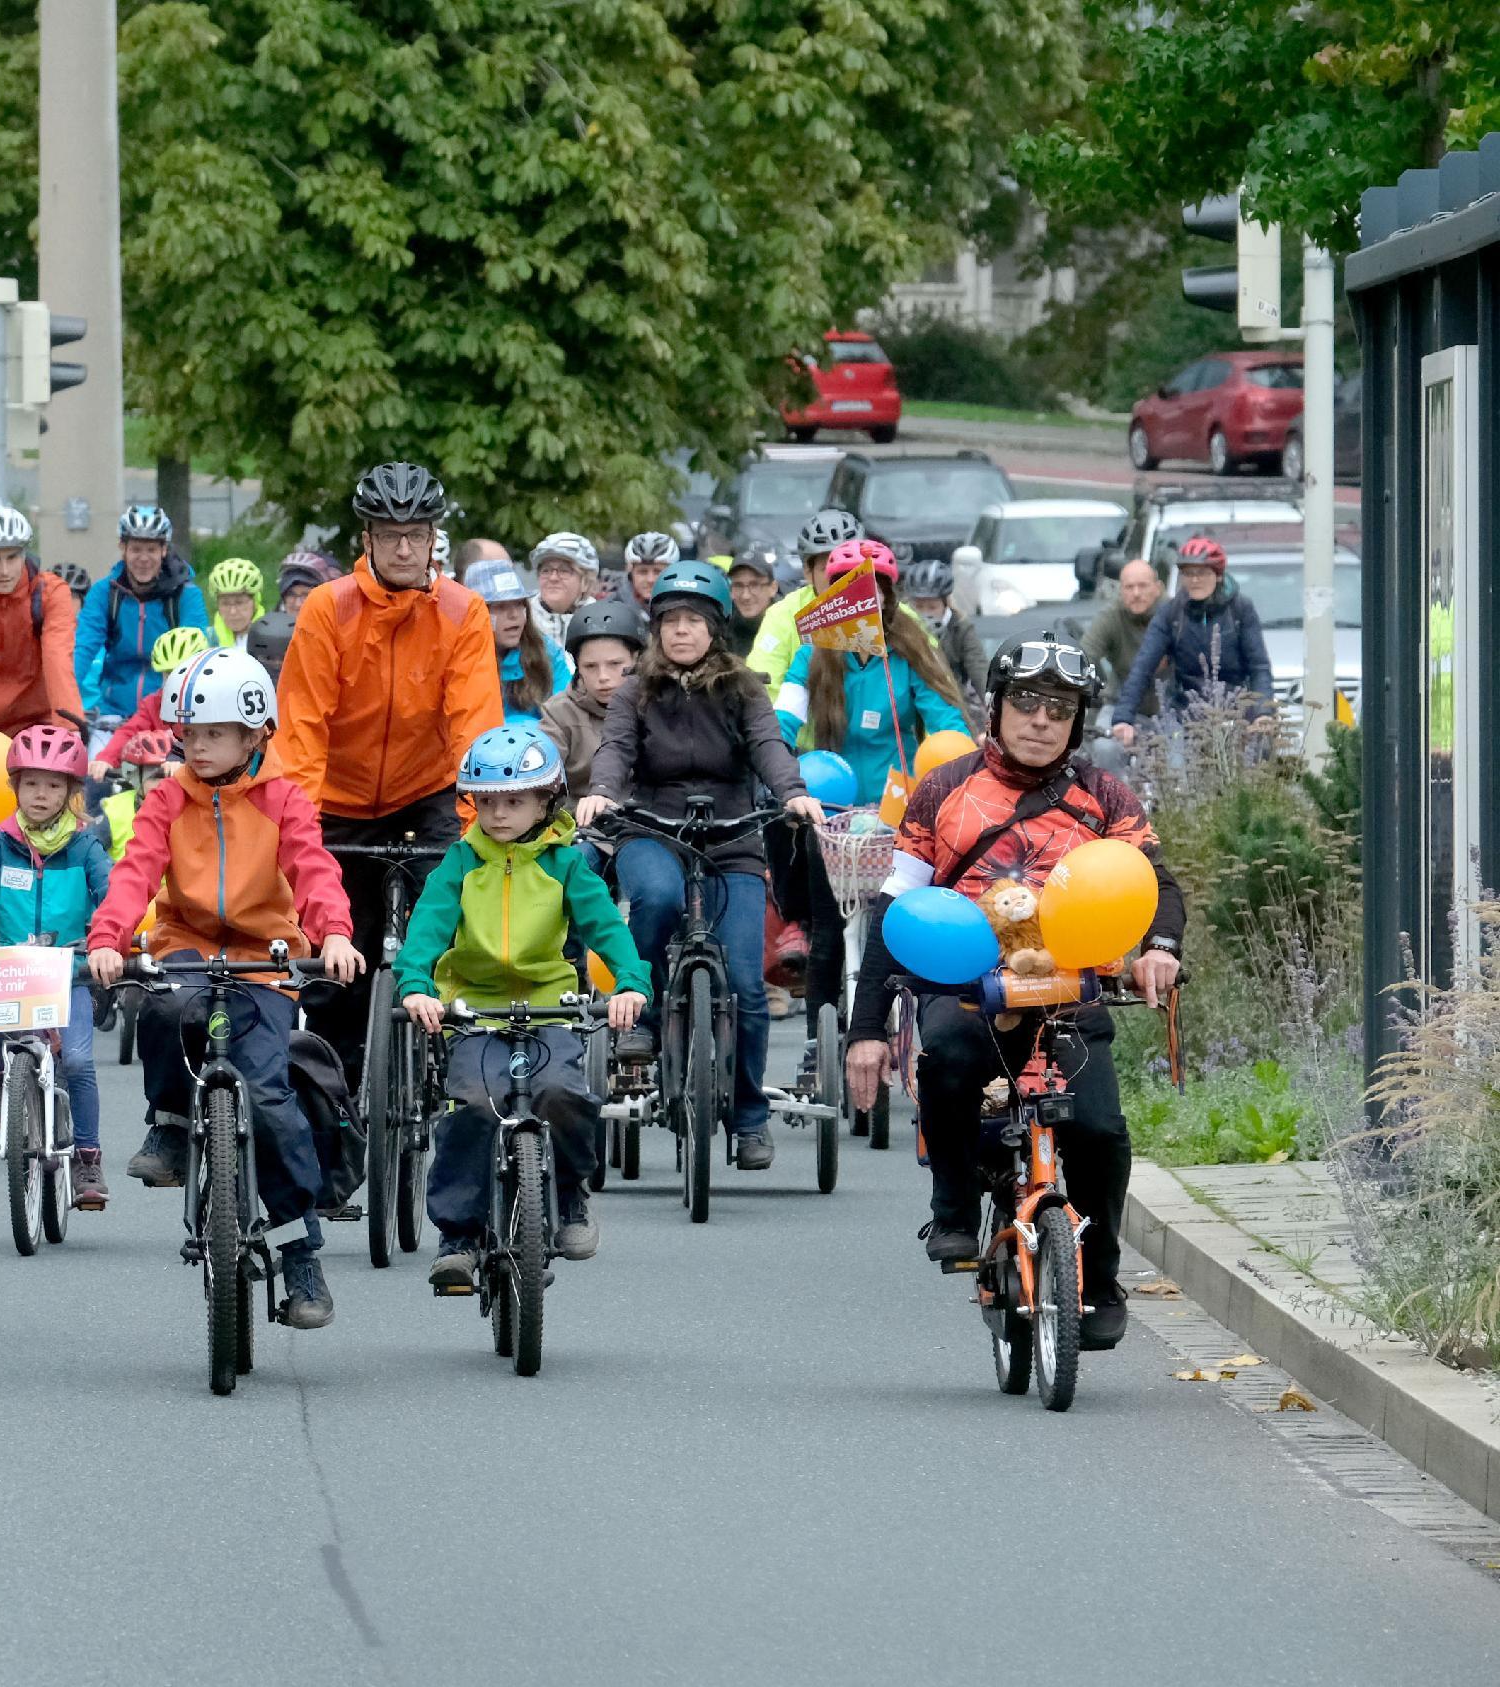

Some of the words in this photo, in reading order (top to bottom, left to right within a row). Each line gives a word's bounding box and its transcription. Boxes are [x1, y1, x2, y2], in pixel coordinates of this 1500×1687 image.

[820, 596, 849, 614] Platz,
[826, 597, 877, 622] Rabatz
[242, 689, 266, 715] 53
[5, 979, 27, 992] mir
